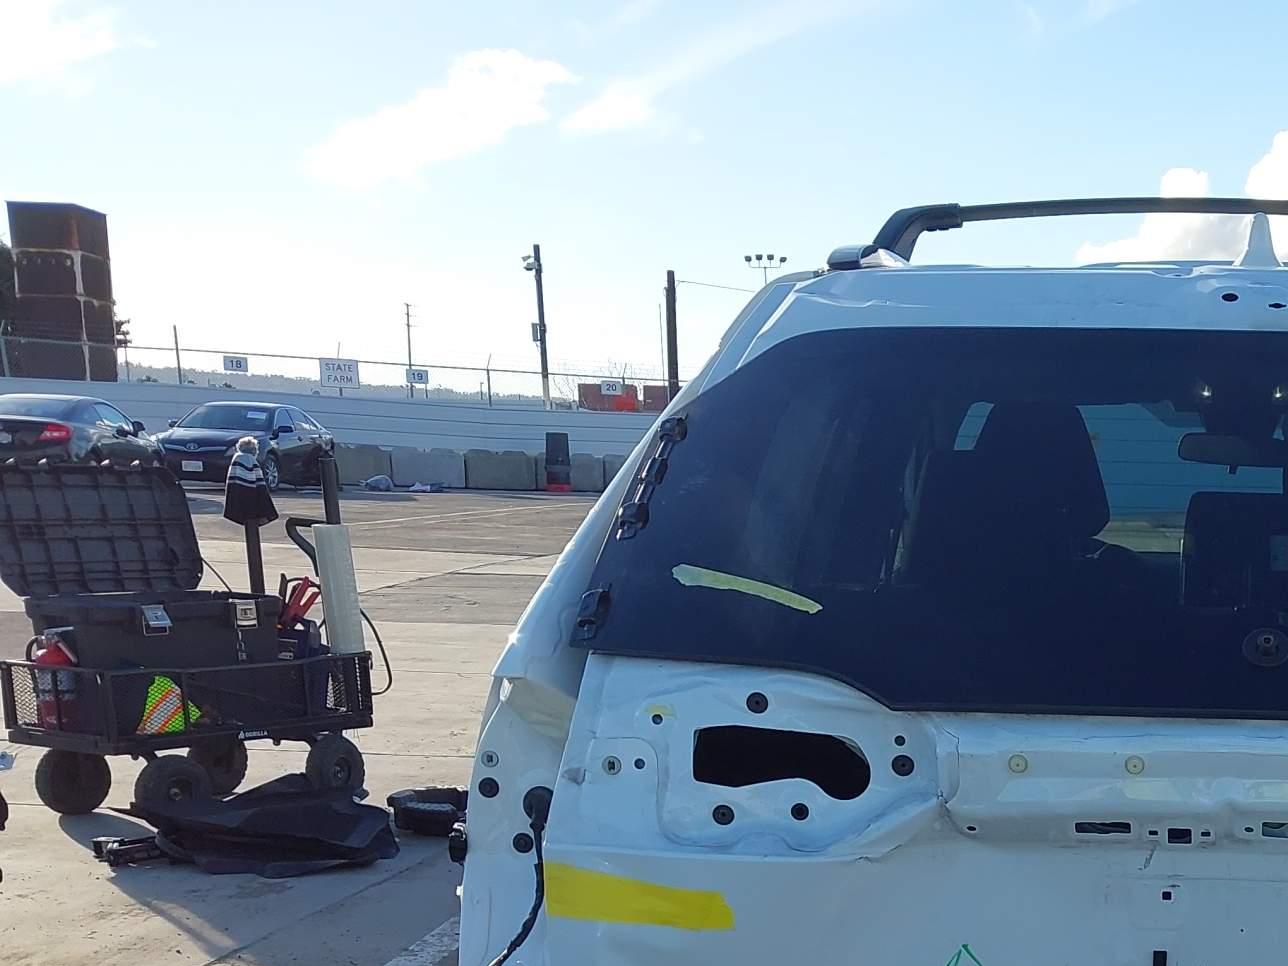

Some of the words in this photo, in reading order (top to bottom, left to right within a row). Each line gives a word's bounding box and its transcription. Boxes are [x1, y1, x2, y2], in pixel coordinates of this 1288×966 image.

[229, 359, 242, 369] 18
[325, 362, 353, 372] STATE
[327, 374, 353, 384] FARM
[411, 372, 423, 381] 19
[605, 383, 617, 392] 20
